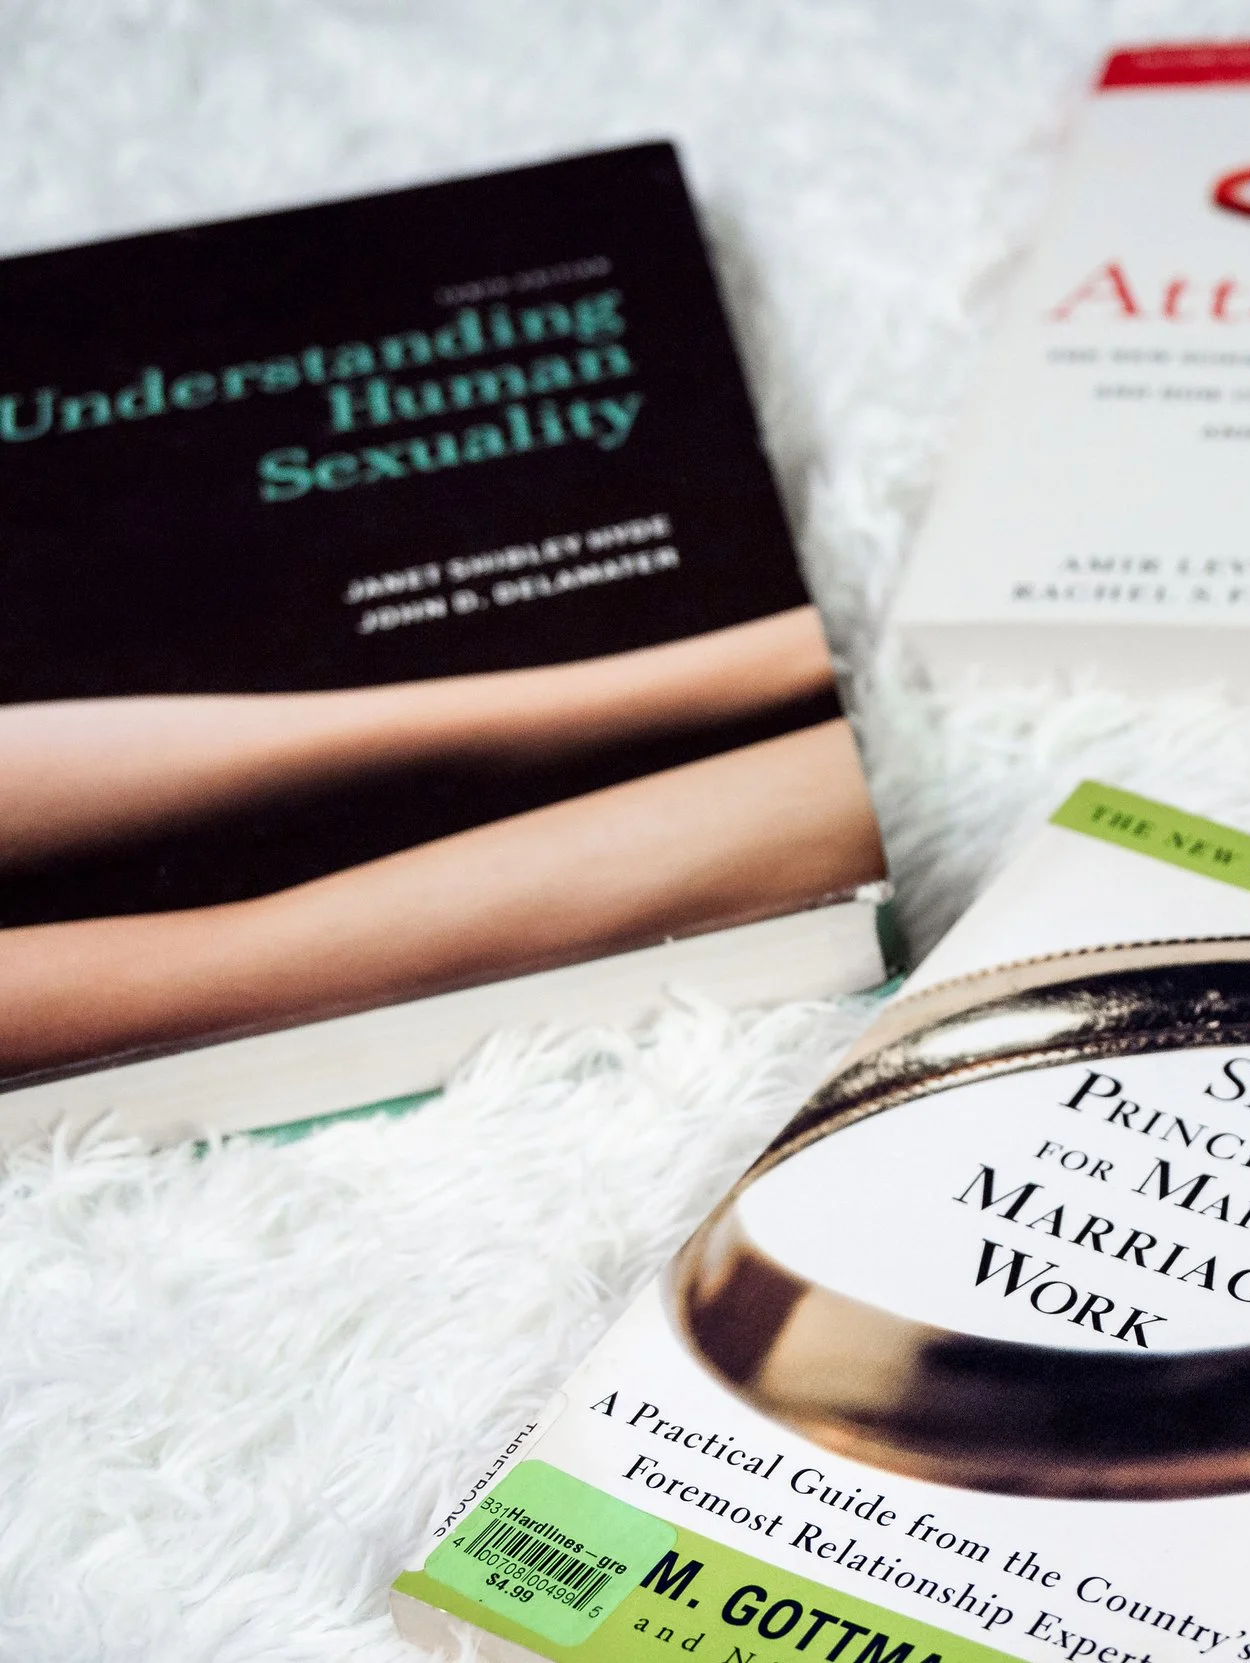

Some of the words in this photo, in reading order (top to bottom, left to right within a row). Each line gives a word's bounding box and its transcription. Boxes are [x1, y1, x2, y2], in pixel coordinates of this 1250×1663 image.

[0, 289, 626, 443] Understanding
[328, 343, 633, 435] Human
[258, 392, 644, 501] Sexuality
[1090, 804, 1153, 838] THE
[1163, 829, 1240, 867] NEW
[1033, 1139, 1114, 1182] FOR
[973, 1238, 1169, 1350] WORK
[590, 1391, 619, 1417] A
[626, 1401, 785, 1480] Practical
[790, 1468, 898, 1527] Guide
[905, 1513, 991, 1563] from
[1002, 1551, 1062, 1589] the
[621, 1454, 785, 1538] Foremost
[788, 1521, 1014, 1632] Relationship
[486, 1572, 535, 1603] $4.99
[633, 1617, 706, 1653] and
[639, 1549, 705, 1610] M.
[721, 1584, 944, 1663] GOTTM
